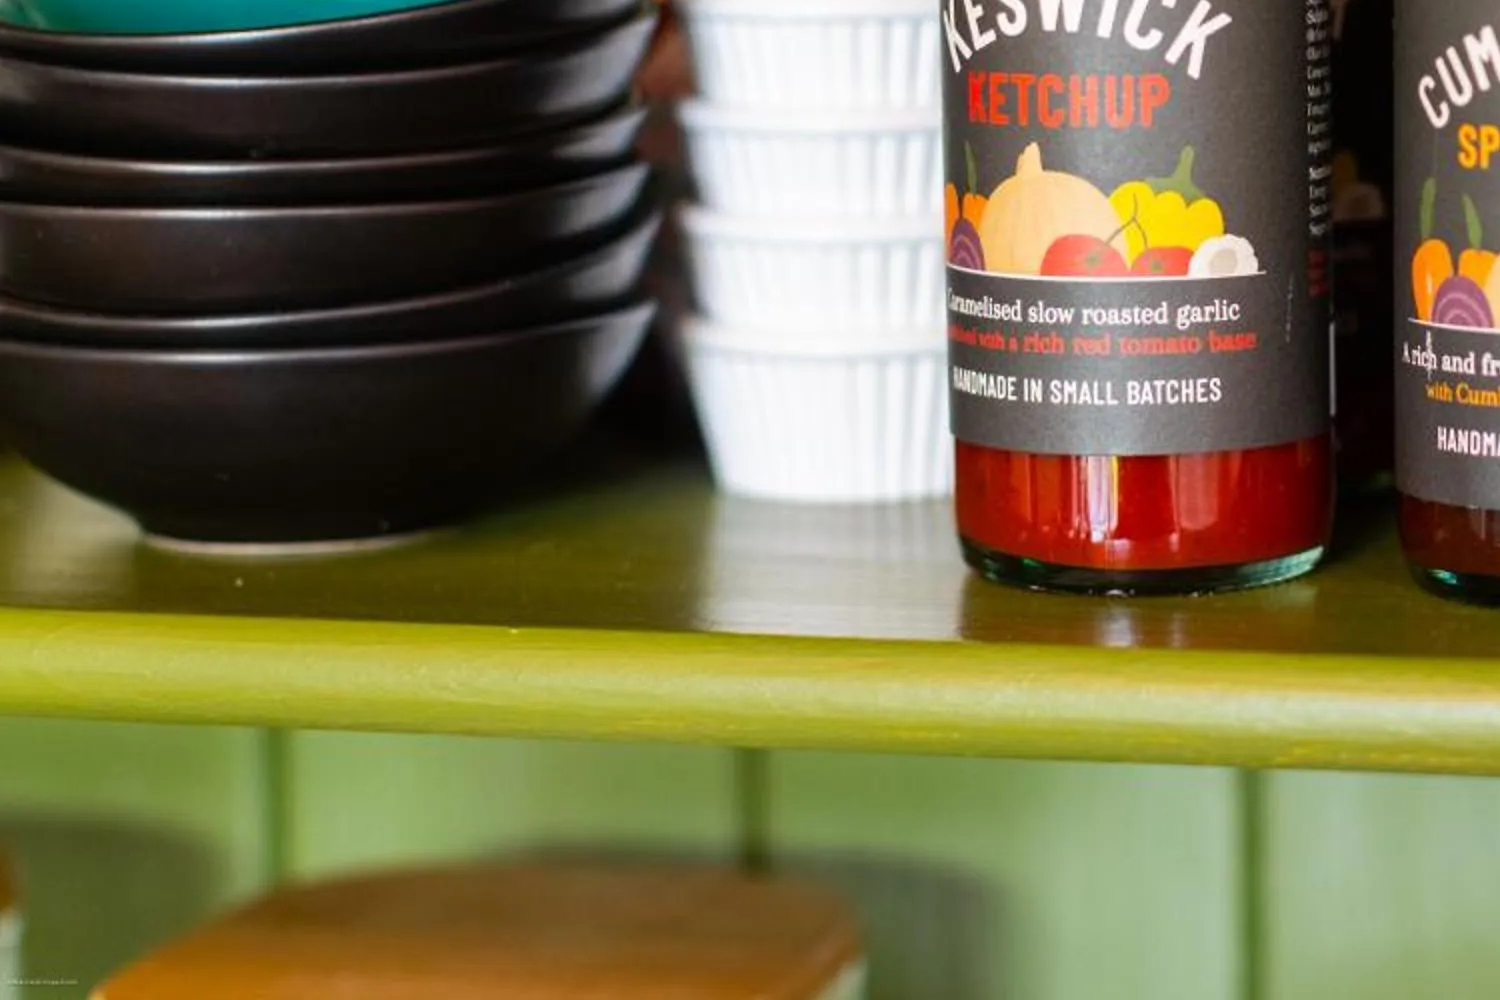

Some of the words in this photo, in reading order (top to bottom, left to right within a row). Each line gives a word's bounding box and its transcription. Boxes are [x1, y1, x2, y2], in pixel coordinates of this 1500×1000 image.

[968, 70, 1171, 129] KETCHUP
[1028, 301, 1074, 325] slow
[1081, 302, 1168, 326] roasted
[1176, 299, 1241, 330] garlic
[1022, 330, 1065, 354] rich
[1073, 331, 1111, 356] red
[1119, 334, 1201, 356] tomato
[1411, 344, 1437, 370] rich
[1441, 351, 1475, 375] and
[953, 365, 1018, 401] HANDMADE
[1023, 377, 1043, 403] IN
[1050, 379, 1118, 405] SMALL
[1126, 377, 1222, 405] BATCHES
